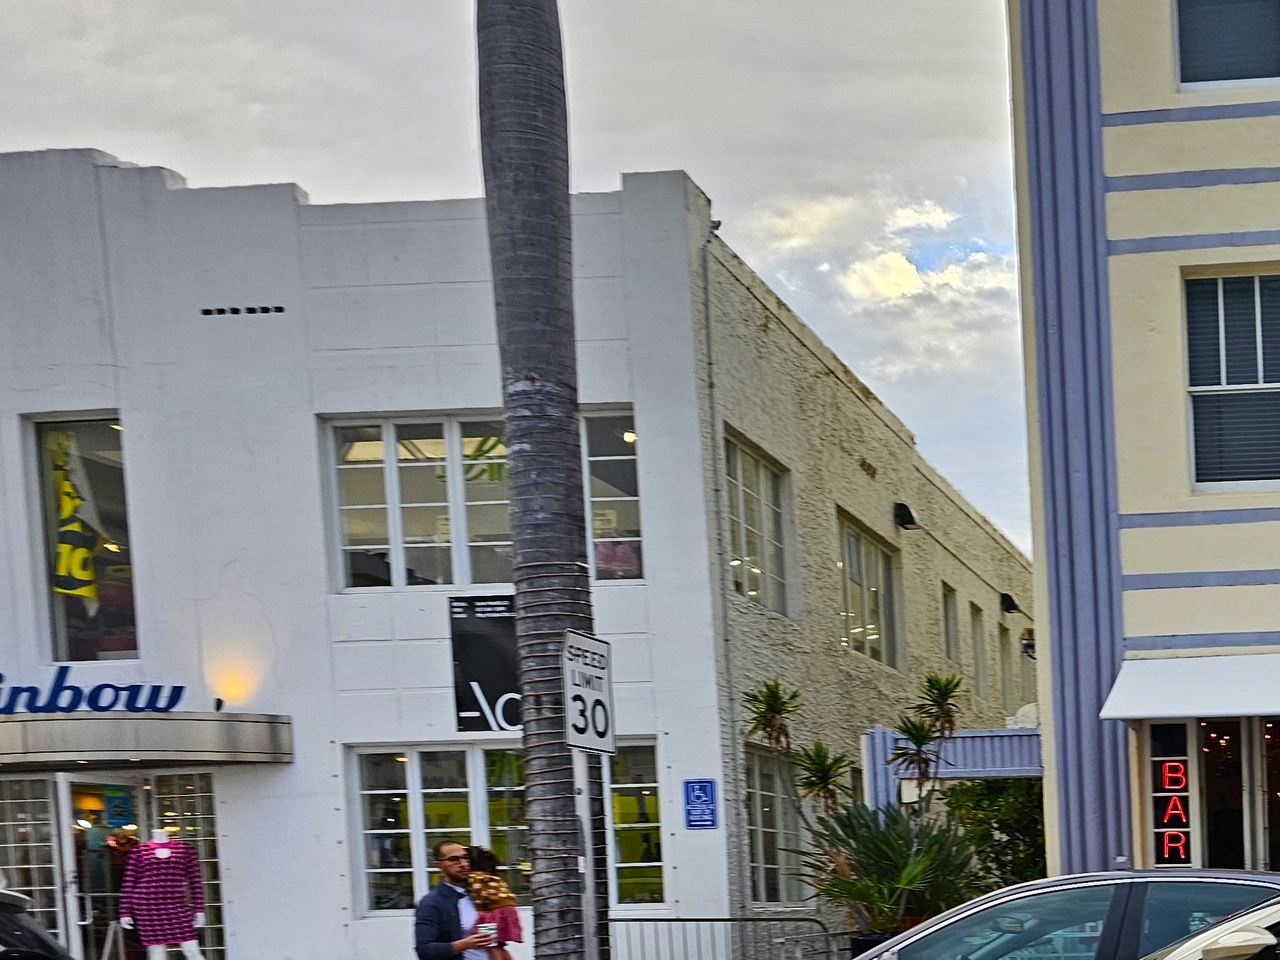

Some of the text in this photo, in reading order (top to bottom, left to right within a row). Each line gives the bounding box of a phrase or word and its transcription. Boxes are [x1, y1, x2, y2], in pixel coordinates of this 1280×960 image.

[566, 644, 608, 670] SPEED
[570, 669, 605, 693] LIMIT
[571, 694, 609, 739] 30
[1163, 762, 1186, 858] BAR
